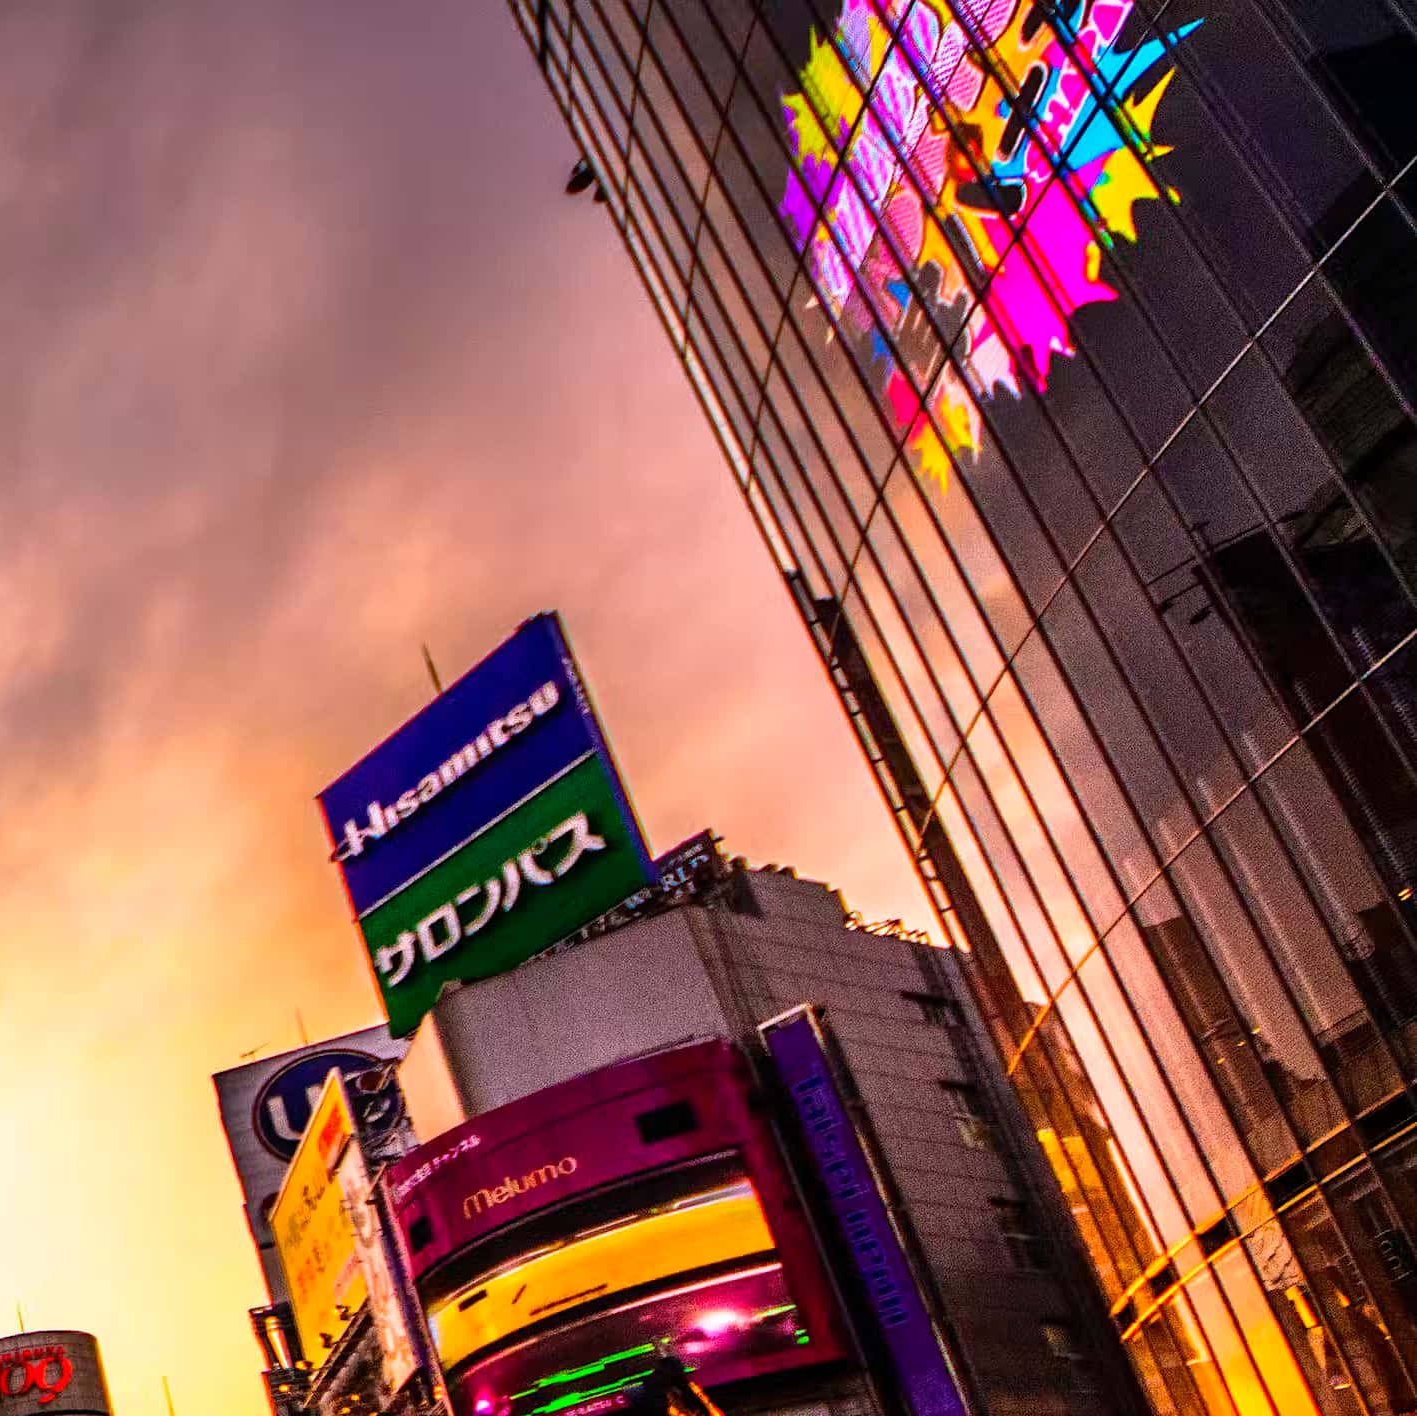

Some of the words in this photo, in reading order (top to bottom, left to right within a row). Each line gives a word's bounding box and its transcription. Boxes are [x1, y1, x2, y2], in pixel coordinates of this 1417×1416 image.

[376, 811, 607, 988] サロンパス
